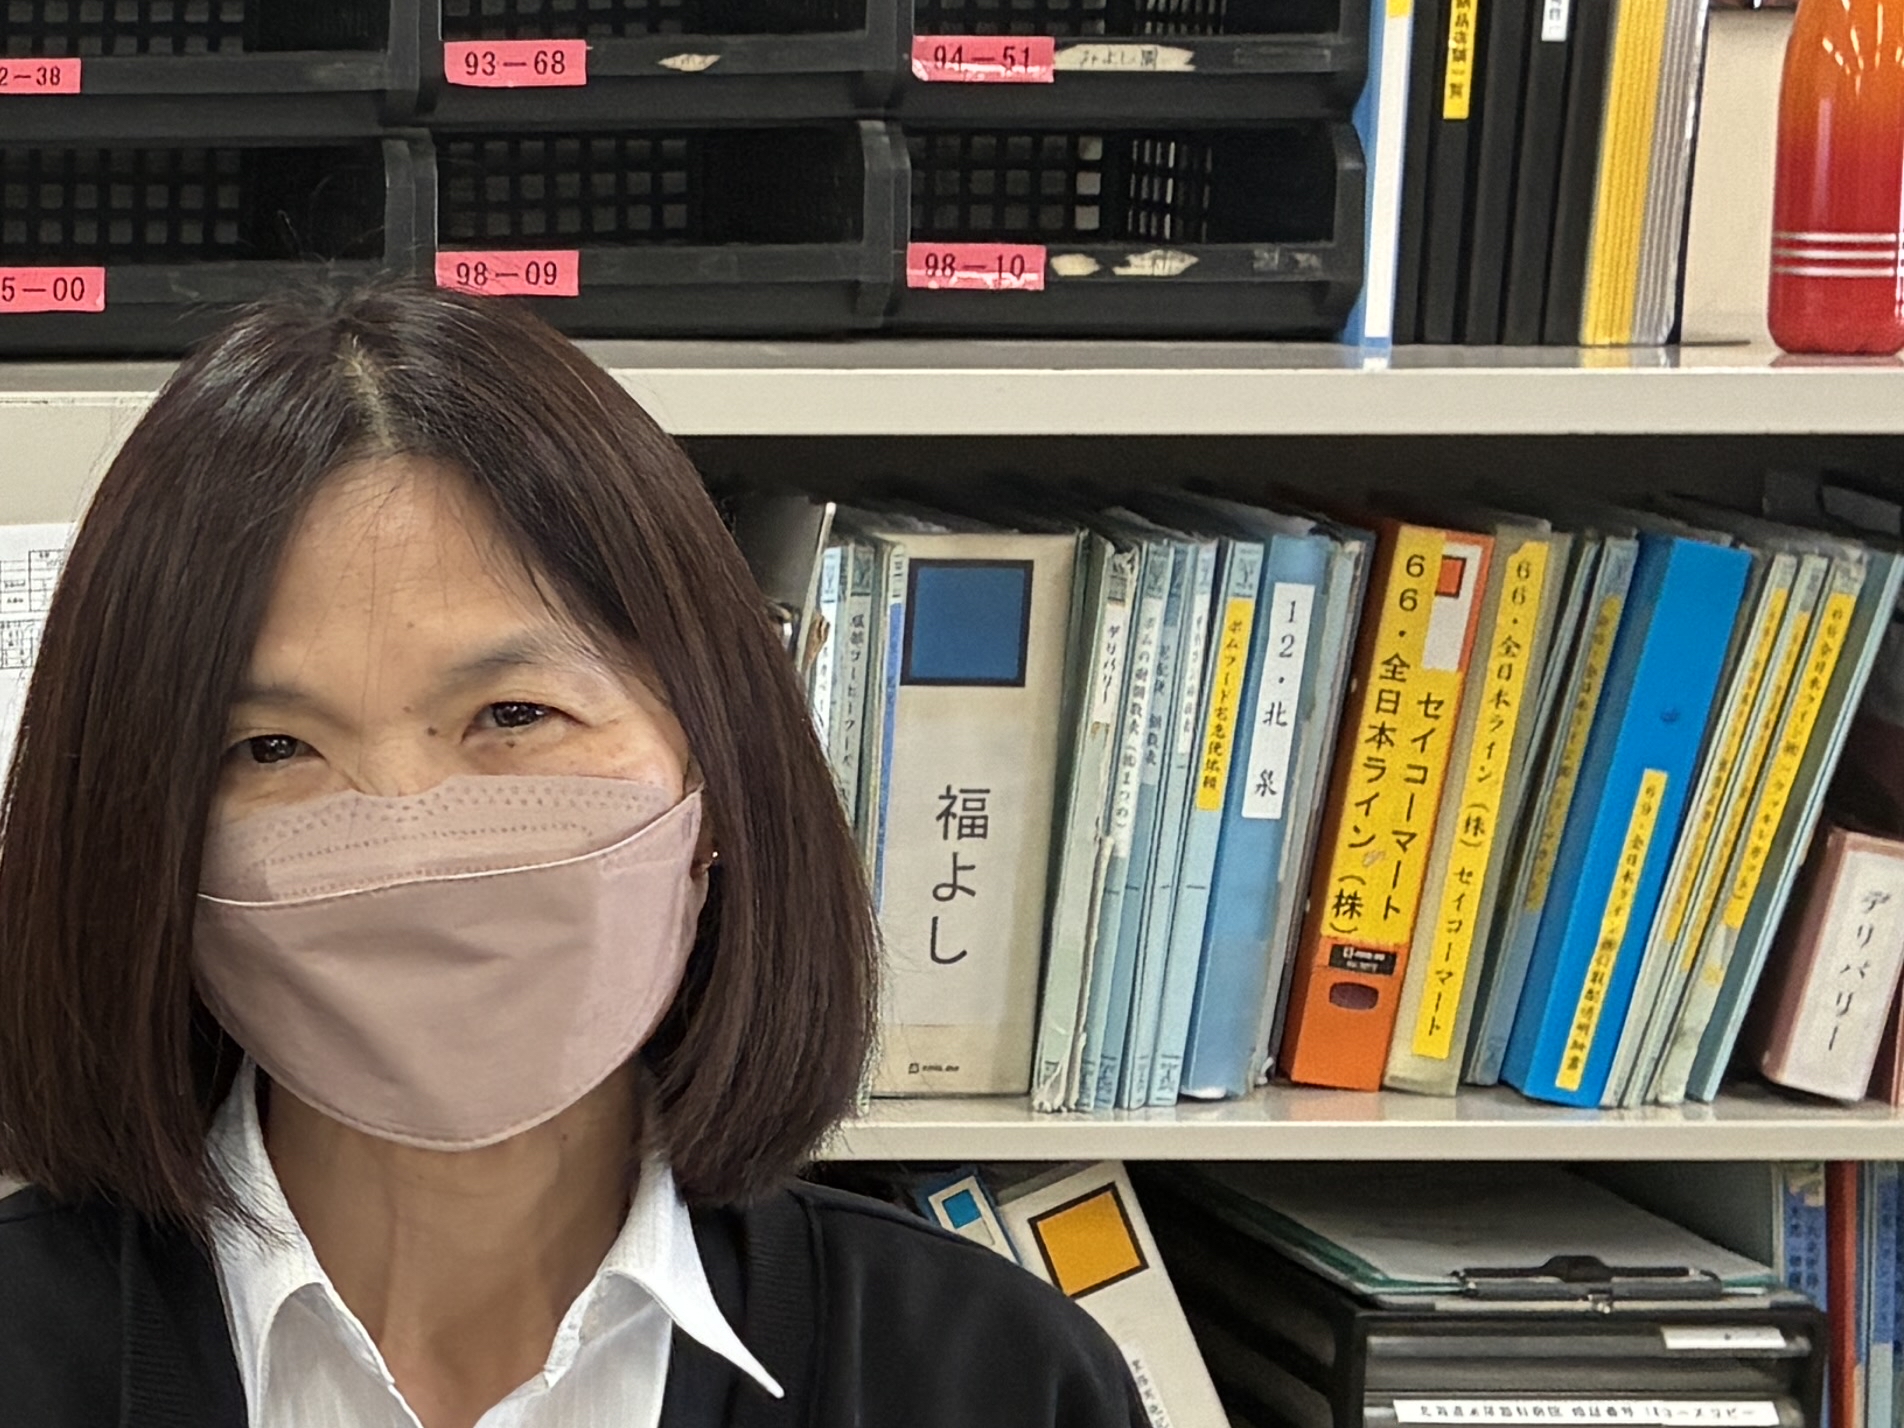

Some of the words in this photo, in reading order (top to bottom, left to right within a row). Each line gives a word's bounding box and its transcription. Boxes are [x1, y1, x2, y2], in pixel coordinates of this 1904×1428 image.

[463, 50, 566, 76] 93-68
[933, 45, 1031, 72] 94-51
[455, 260, 559, 288] 98-09
[925, 252, 1026, 280] 98-10
[1380, 691, 1445, 921] セイコーマート
[928, 783, 992, 966] 福よし
[1427, 866, 1476, 1038] セイコーマート
[1826, 891, 1891, 1052] デリバリー
